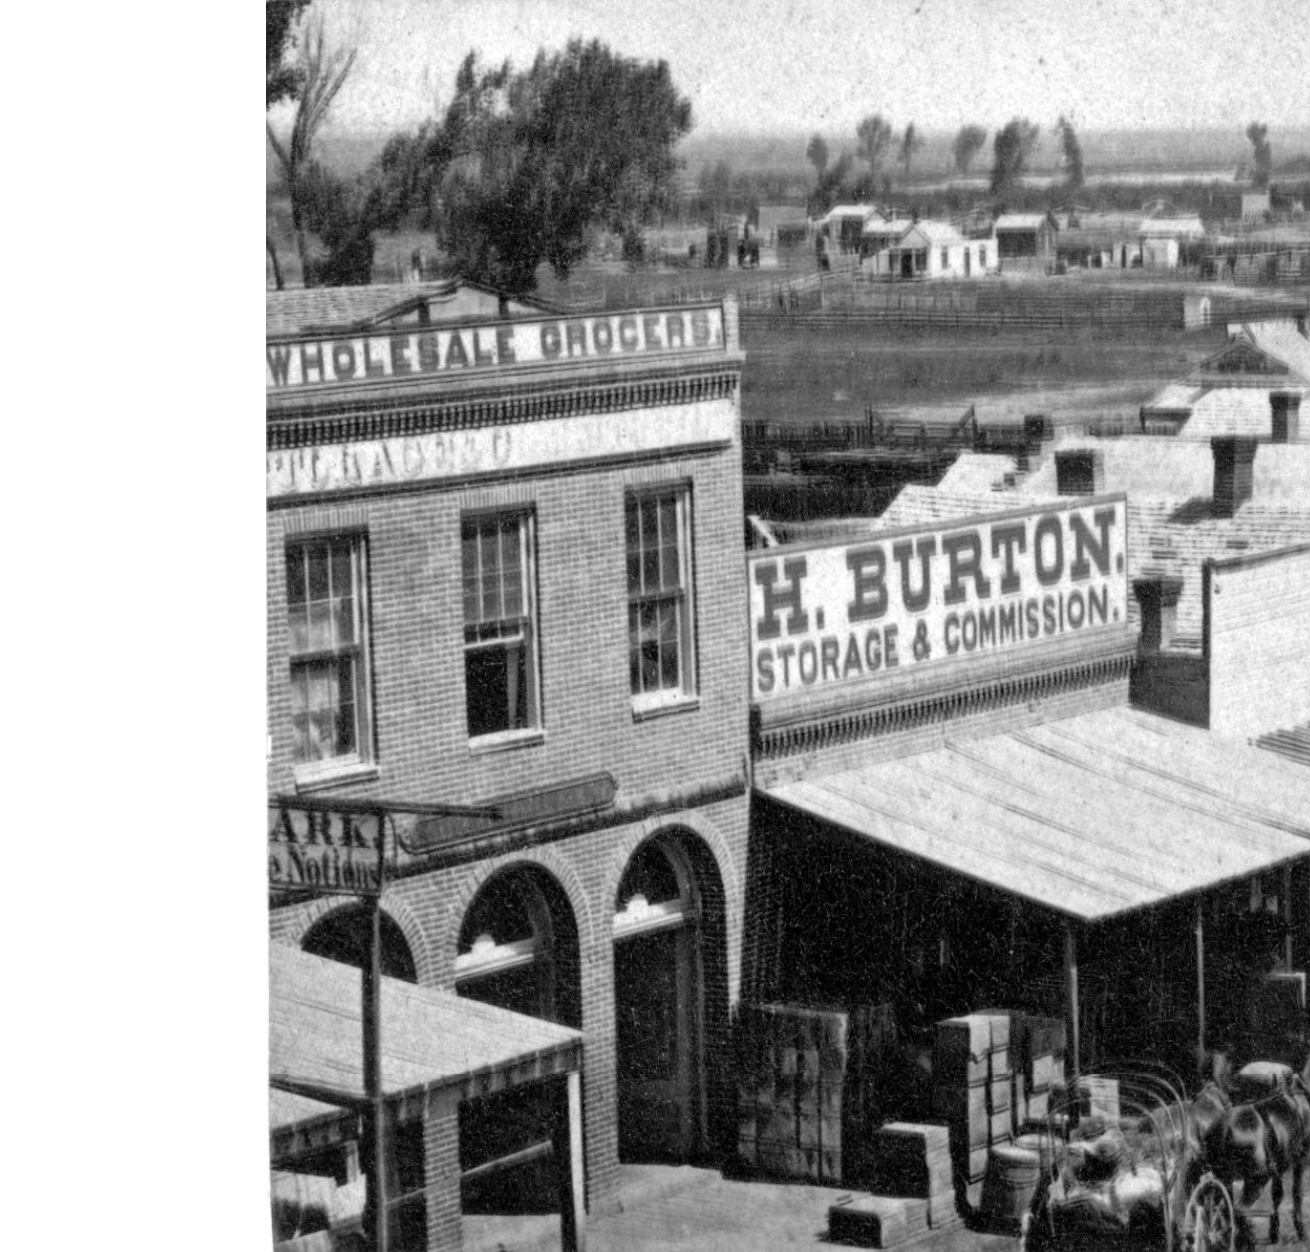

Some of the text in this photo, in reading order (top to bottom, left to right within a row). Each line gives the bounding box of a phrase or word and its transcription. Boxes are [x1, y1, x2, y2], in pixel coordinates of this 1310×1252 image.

[267, 330, 516, 387] WHOLESALE
[754, 505, 1124, 641] H. BURTON.
[756, 584, 1119, 693] STORAGE & COMMISSION.
